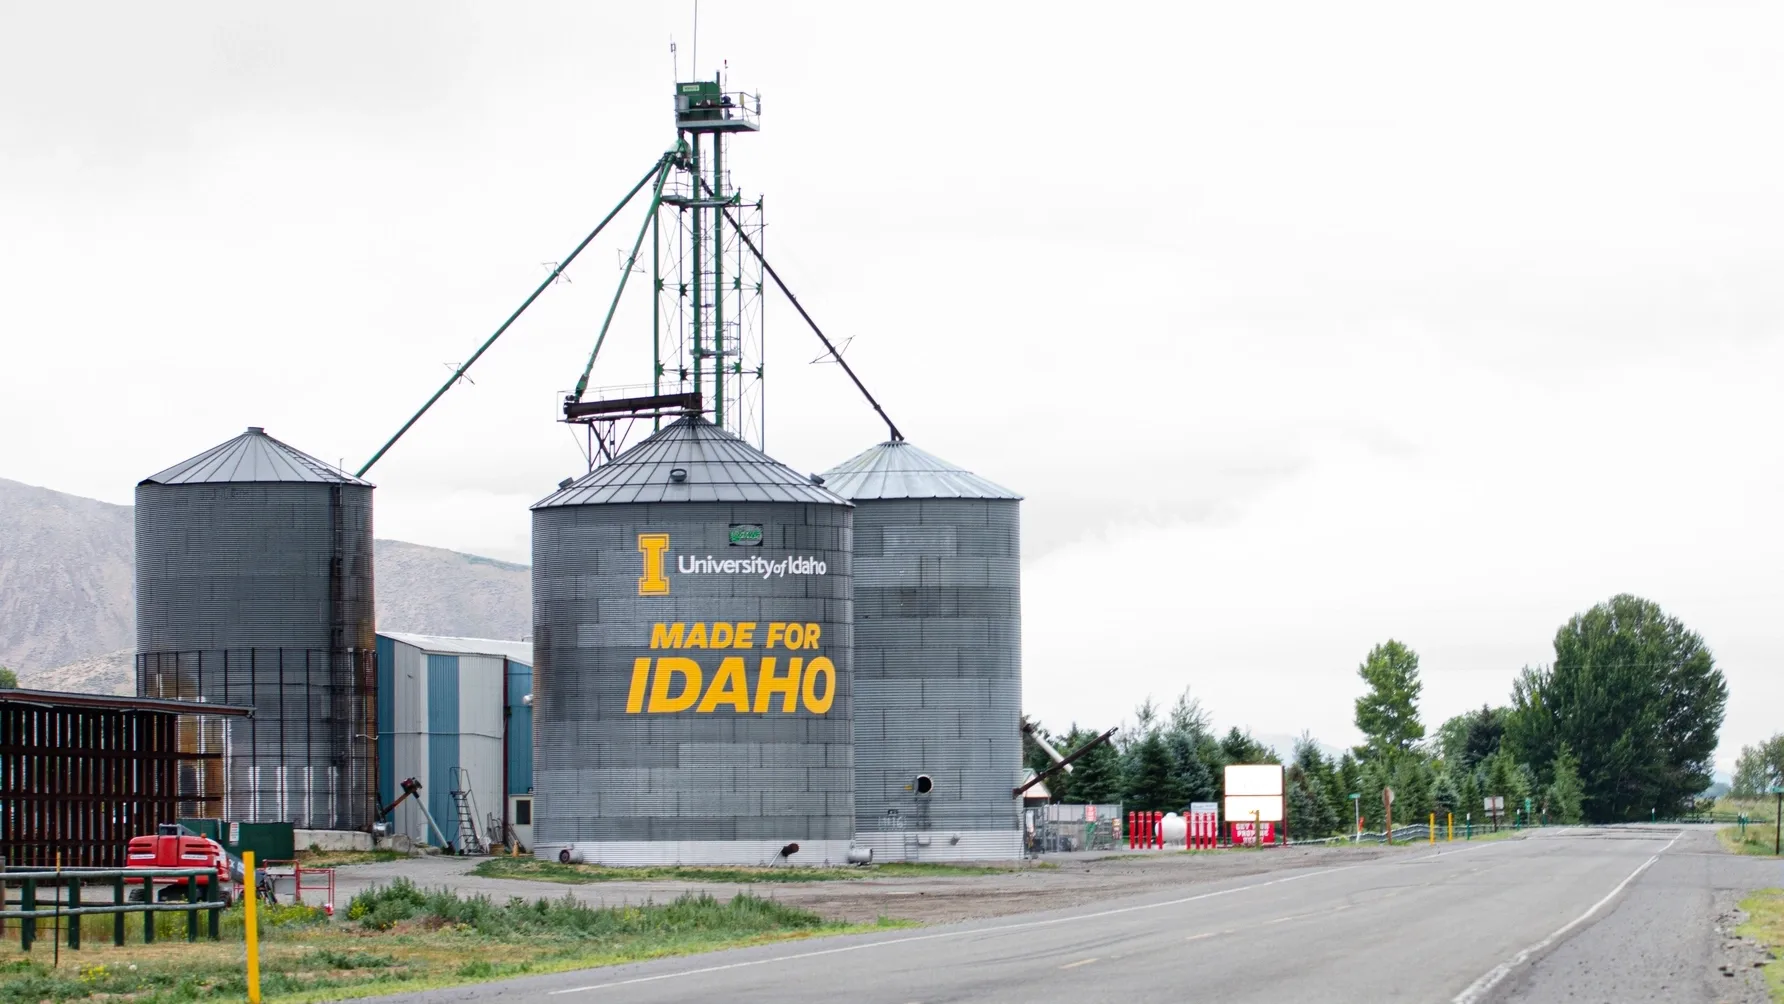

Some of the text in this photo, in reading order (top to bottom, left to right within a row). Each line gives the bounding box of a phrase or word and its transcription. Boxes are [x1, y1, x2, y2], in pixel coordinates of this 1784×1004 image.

[678, 555, 827, 579] University of Idaho
[650, 622, 821, 650] MADE FOR
[626, 656, 836, 714] IDAHO
[1236, 829, 1269, 837] PROPNE
[1251, 822, 1269, 830] YUR
